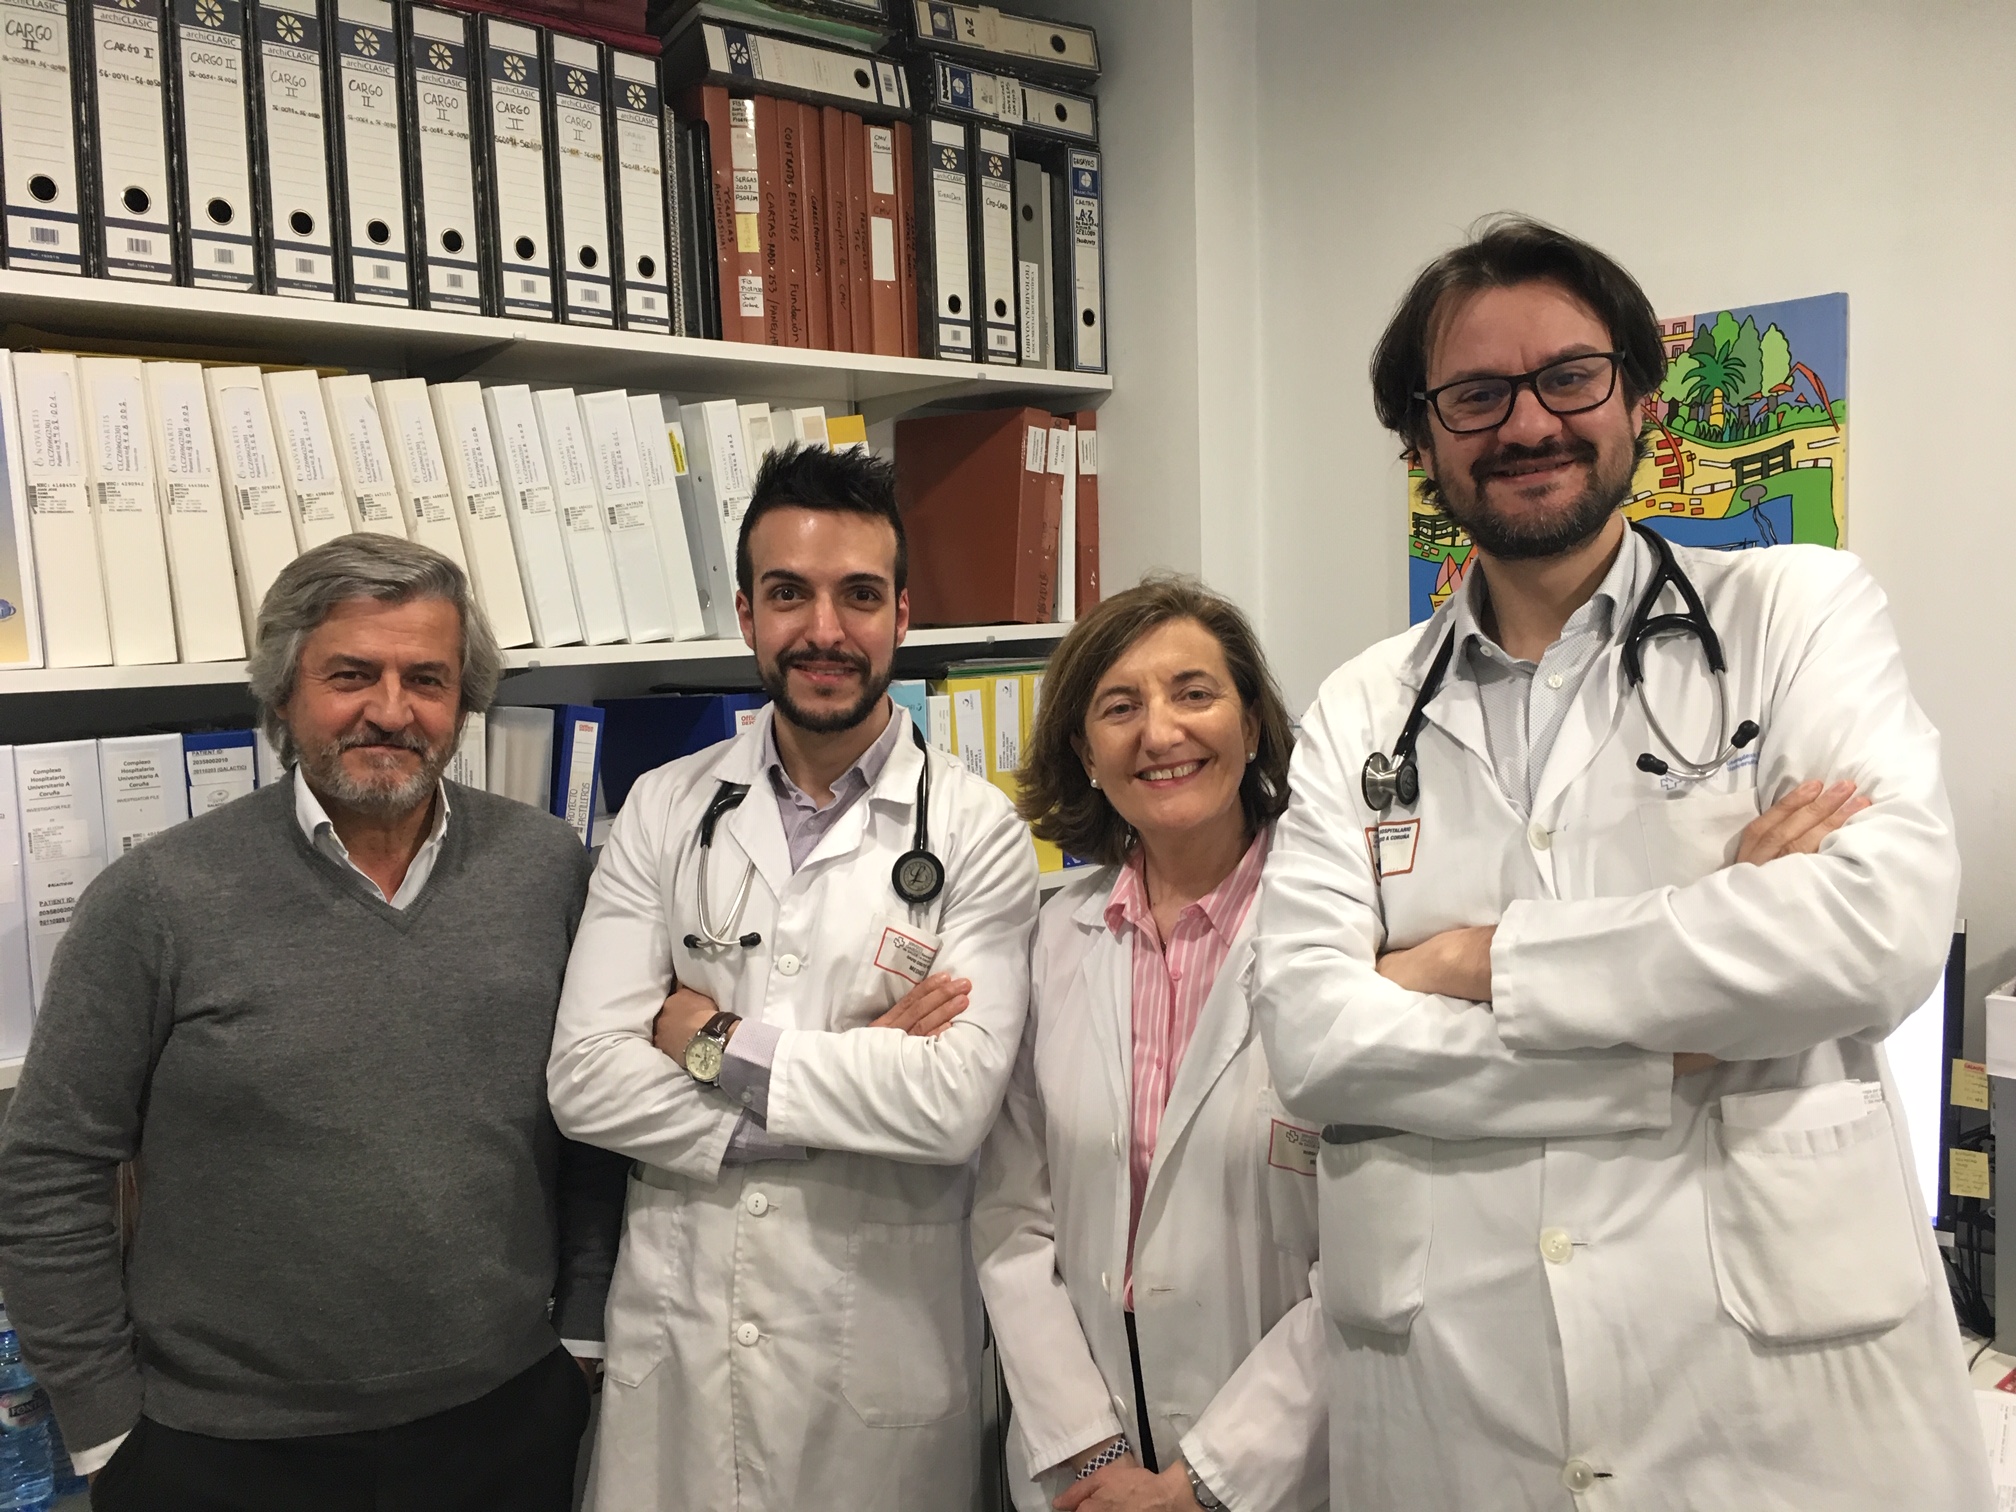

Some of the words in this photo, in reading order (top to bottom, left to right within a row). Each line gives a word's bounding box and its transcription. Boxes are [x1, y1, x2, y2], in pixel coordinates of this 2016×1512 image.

[100, 12, 153, 29] archiCLASIC
[5, 19, 53, 41] CARGO
[22, 38, 41, 52] II
[186, 31, 236, 47] archiCLASIC
[103, 39, 140, 55] CARGO
[268, 46, 315, 63] archiCLASIC
[190, 51, 223, 66] CARGO
[225, 58, 237, 70] II
[346, 60, 391, 75] archiCLASIC
[271, 70, 307, 88] CARGO
[421, 74, 463, 88] archiCLASIC
[285, 86, 298, 98] II
[348, 79, 383, 97] CARGO
[496, 85, 536, 99] archiCLASIC
[361, 95, 375, 108] II
[424, 92, 459, 109] CARGO
[496, 100, 531, 115] CARGO
[560, 98, 597, 112] archiCLASIC
[435, 107, 450, 122] II
[564, 114, 593, 130] CARGO
[620, 112, 655, 126] archiCLASIC
[505, 117, 524, 131] II
[573, 128, 585, 142] II
[784, 127, 795, 187] CONTRATOS
[788, 191, 798, 242] ENSAYOS
[873, 206, 891, 216] CMV
[789, 283, 799, 343] Fundación
[32, 409, 43, 455] NOVARTIS
[102, 415, 112, 459] NOVARTIS
[167, 418, 177, 461] NOVARTIS
[231, 426, 244, 468] NOVARTIS
[120, 766, 155, 774] Hospitalario
[123, 759, 151, 768] Complexo
[30, 774, 66, 783] Hospitalario
[32, 767, 62, 776] Complexo
[117, 774, 153, 783] Universitario
[27, 782, 64, 791] Universitario
[129, 779, 149, 788] Coruña
[39, 789, 61, 797] Coruña
[117, 796, 148, 804] INVESTIGATOR
[26, 805, 58, 813] INVESTIGATOR
[566, 788, 577, 827] PROYECTO
[577, 782, 590, 827] PASTILLEROS
[39, 898, 65, 908] PATIENT
